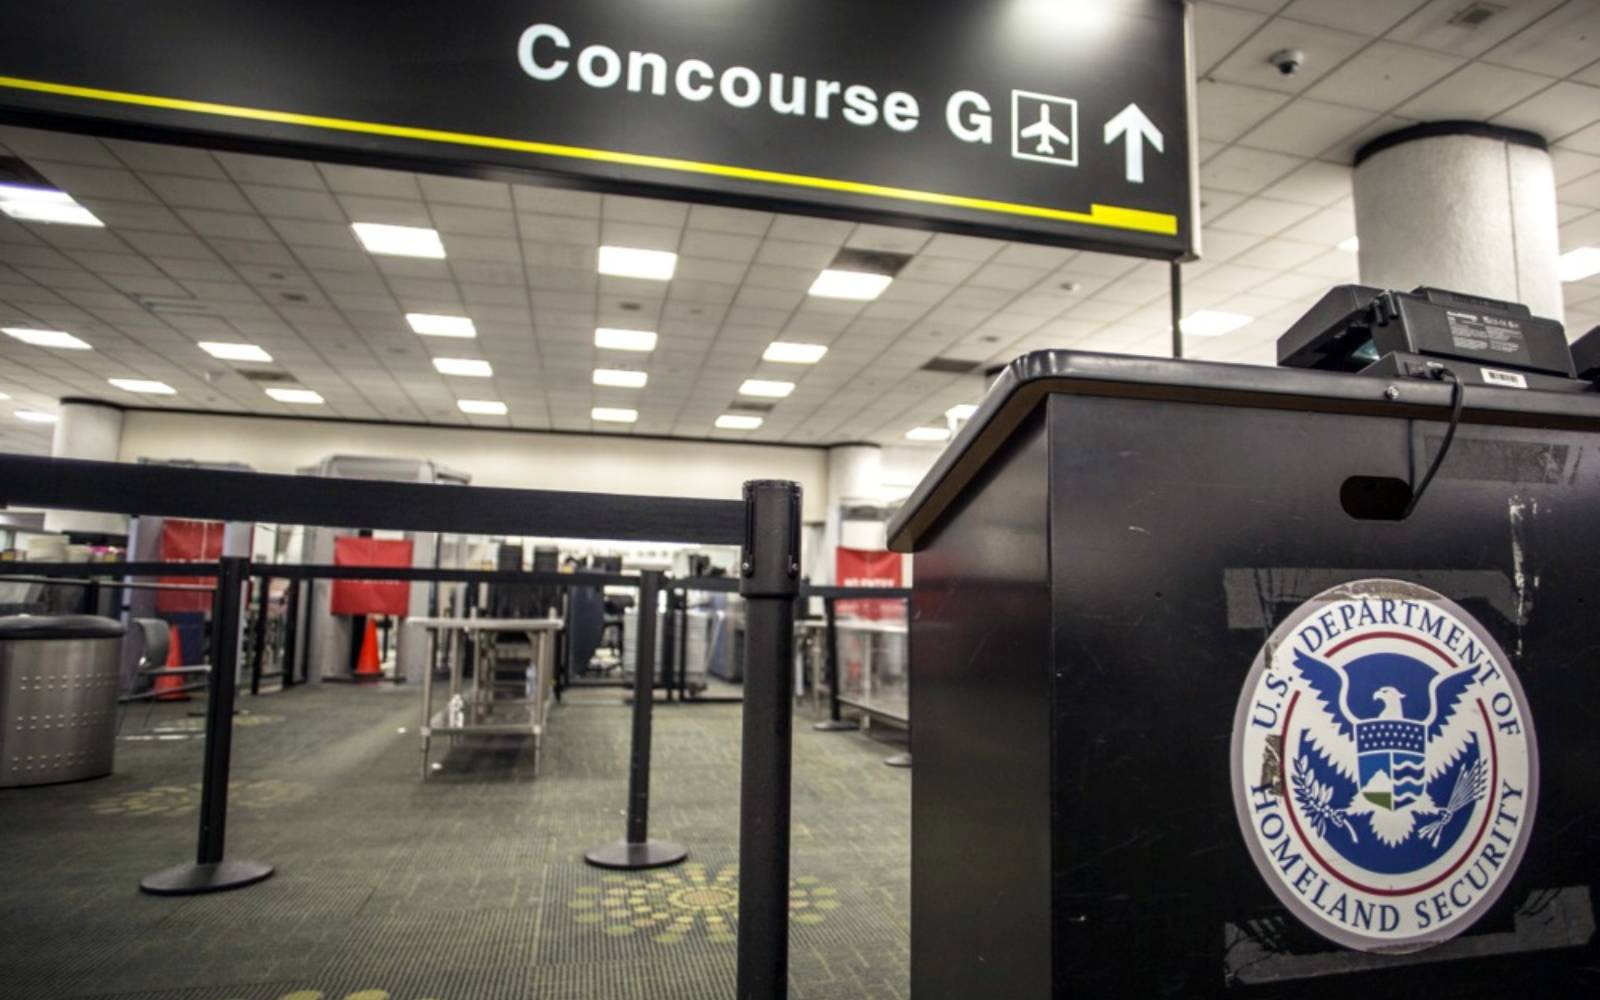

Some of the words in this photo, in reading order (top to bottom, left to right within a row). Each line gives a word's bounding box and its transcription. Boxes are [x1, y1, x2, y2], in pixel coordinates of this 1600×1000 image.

[517, 23, 920, 132] Concourse
[945, 90, 993, 144] G
[1252, 673, 1293, 730] U.S.
[1297, 598, 1500, 687] DEPARTMENT
[1492, 692, 1521, 736] OF
[1251, 783, 1400, 932] HOMELAND
[1414, 779, 1524, 930] SECURITY
